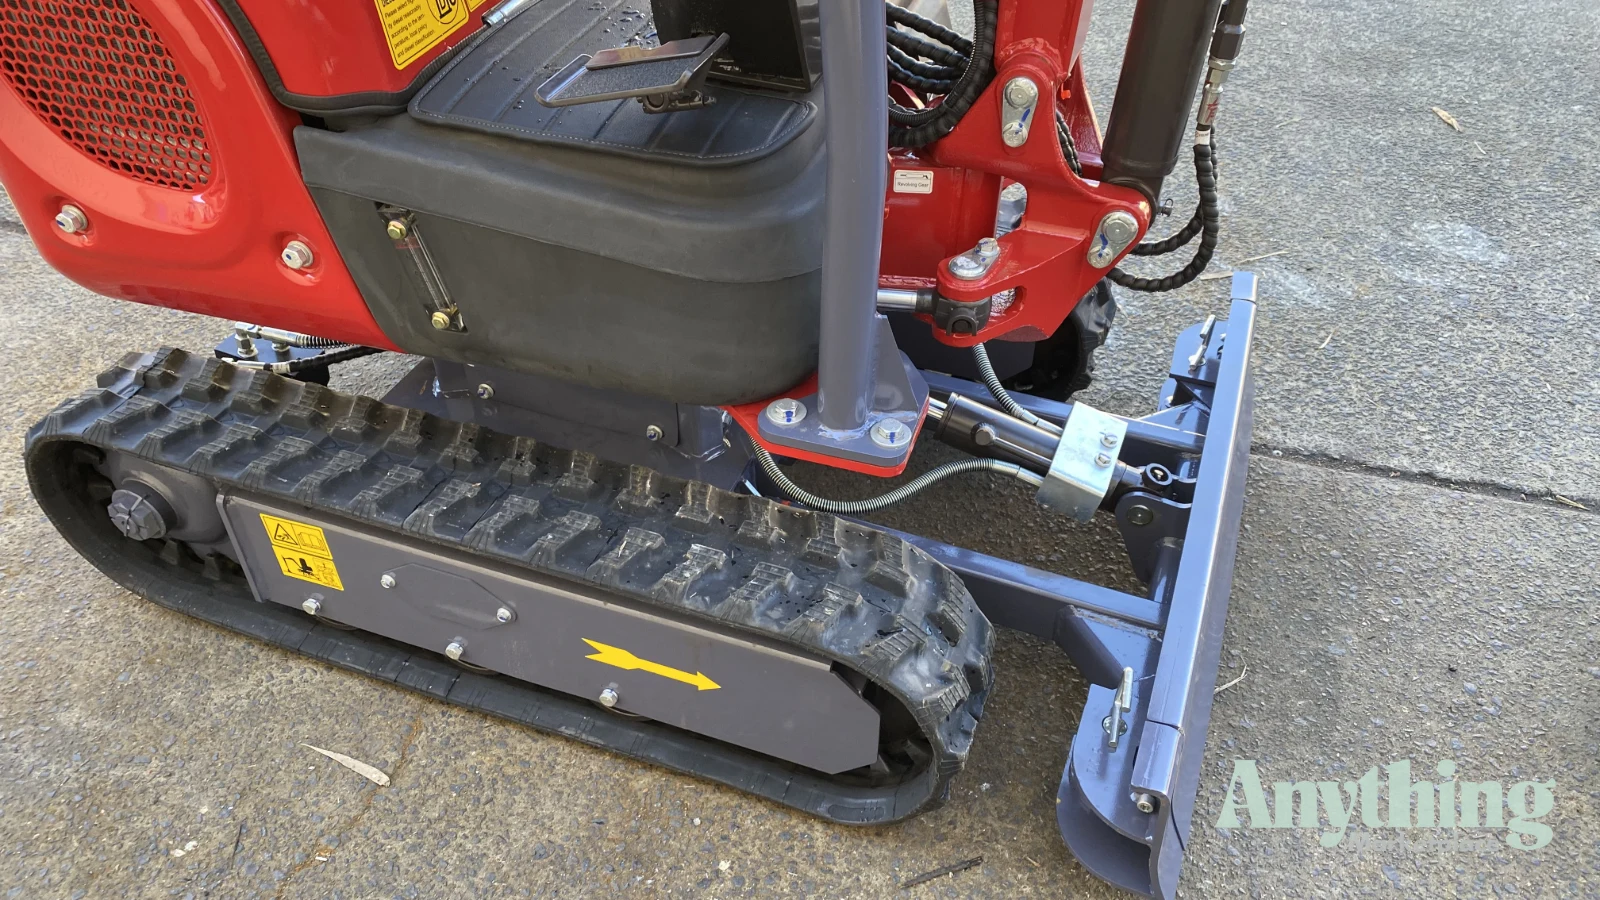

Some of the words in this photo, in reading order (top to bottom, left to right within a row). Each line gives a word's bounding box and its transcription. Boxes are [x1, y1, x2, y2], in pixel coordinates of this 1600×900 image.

[385, 9, 397, 18] Please
[397, 1, 407, 11] select
[392, 16, 403, 26] diesel
[391, 25, 409, 39] according
[397, 50, 405, 58] and
